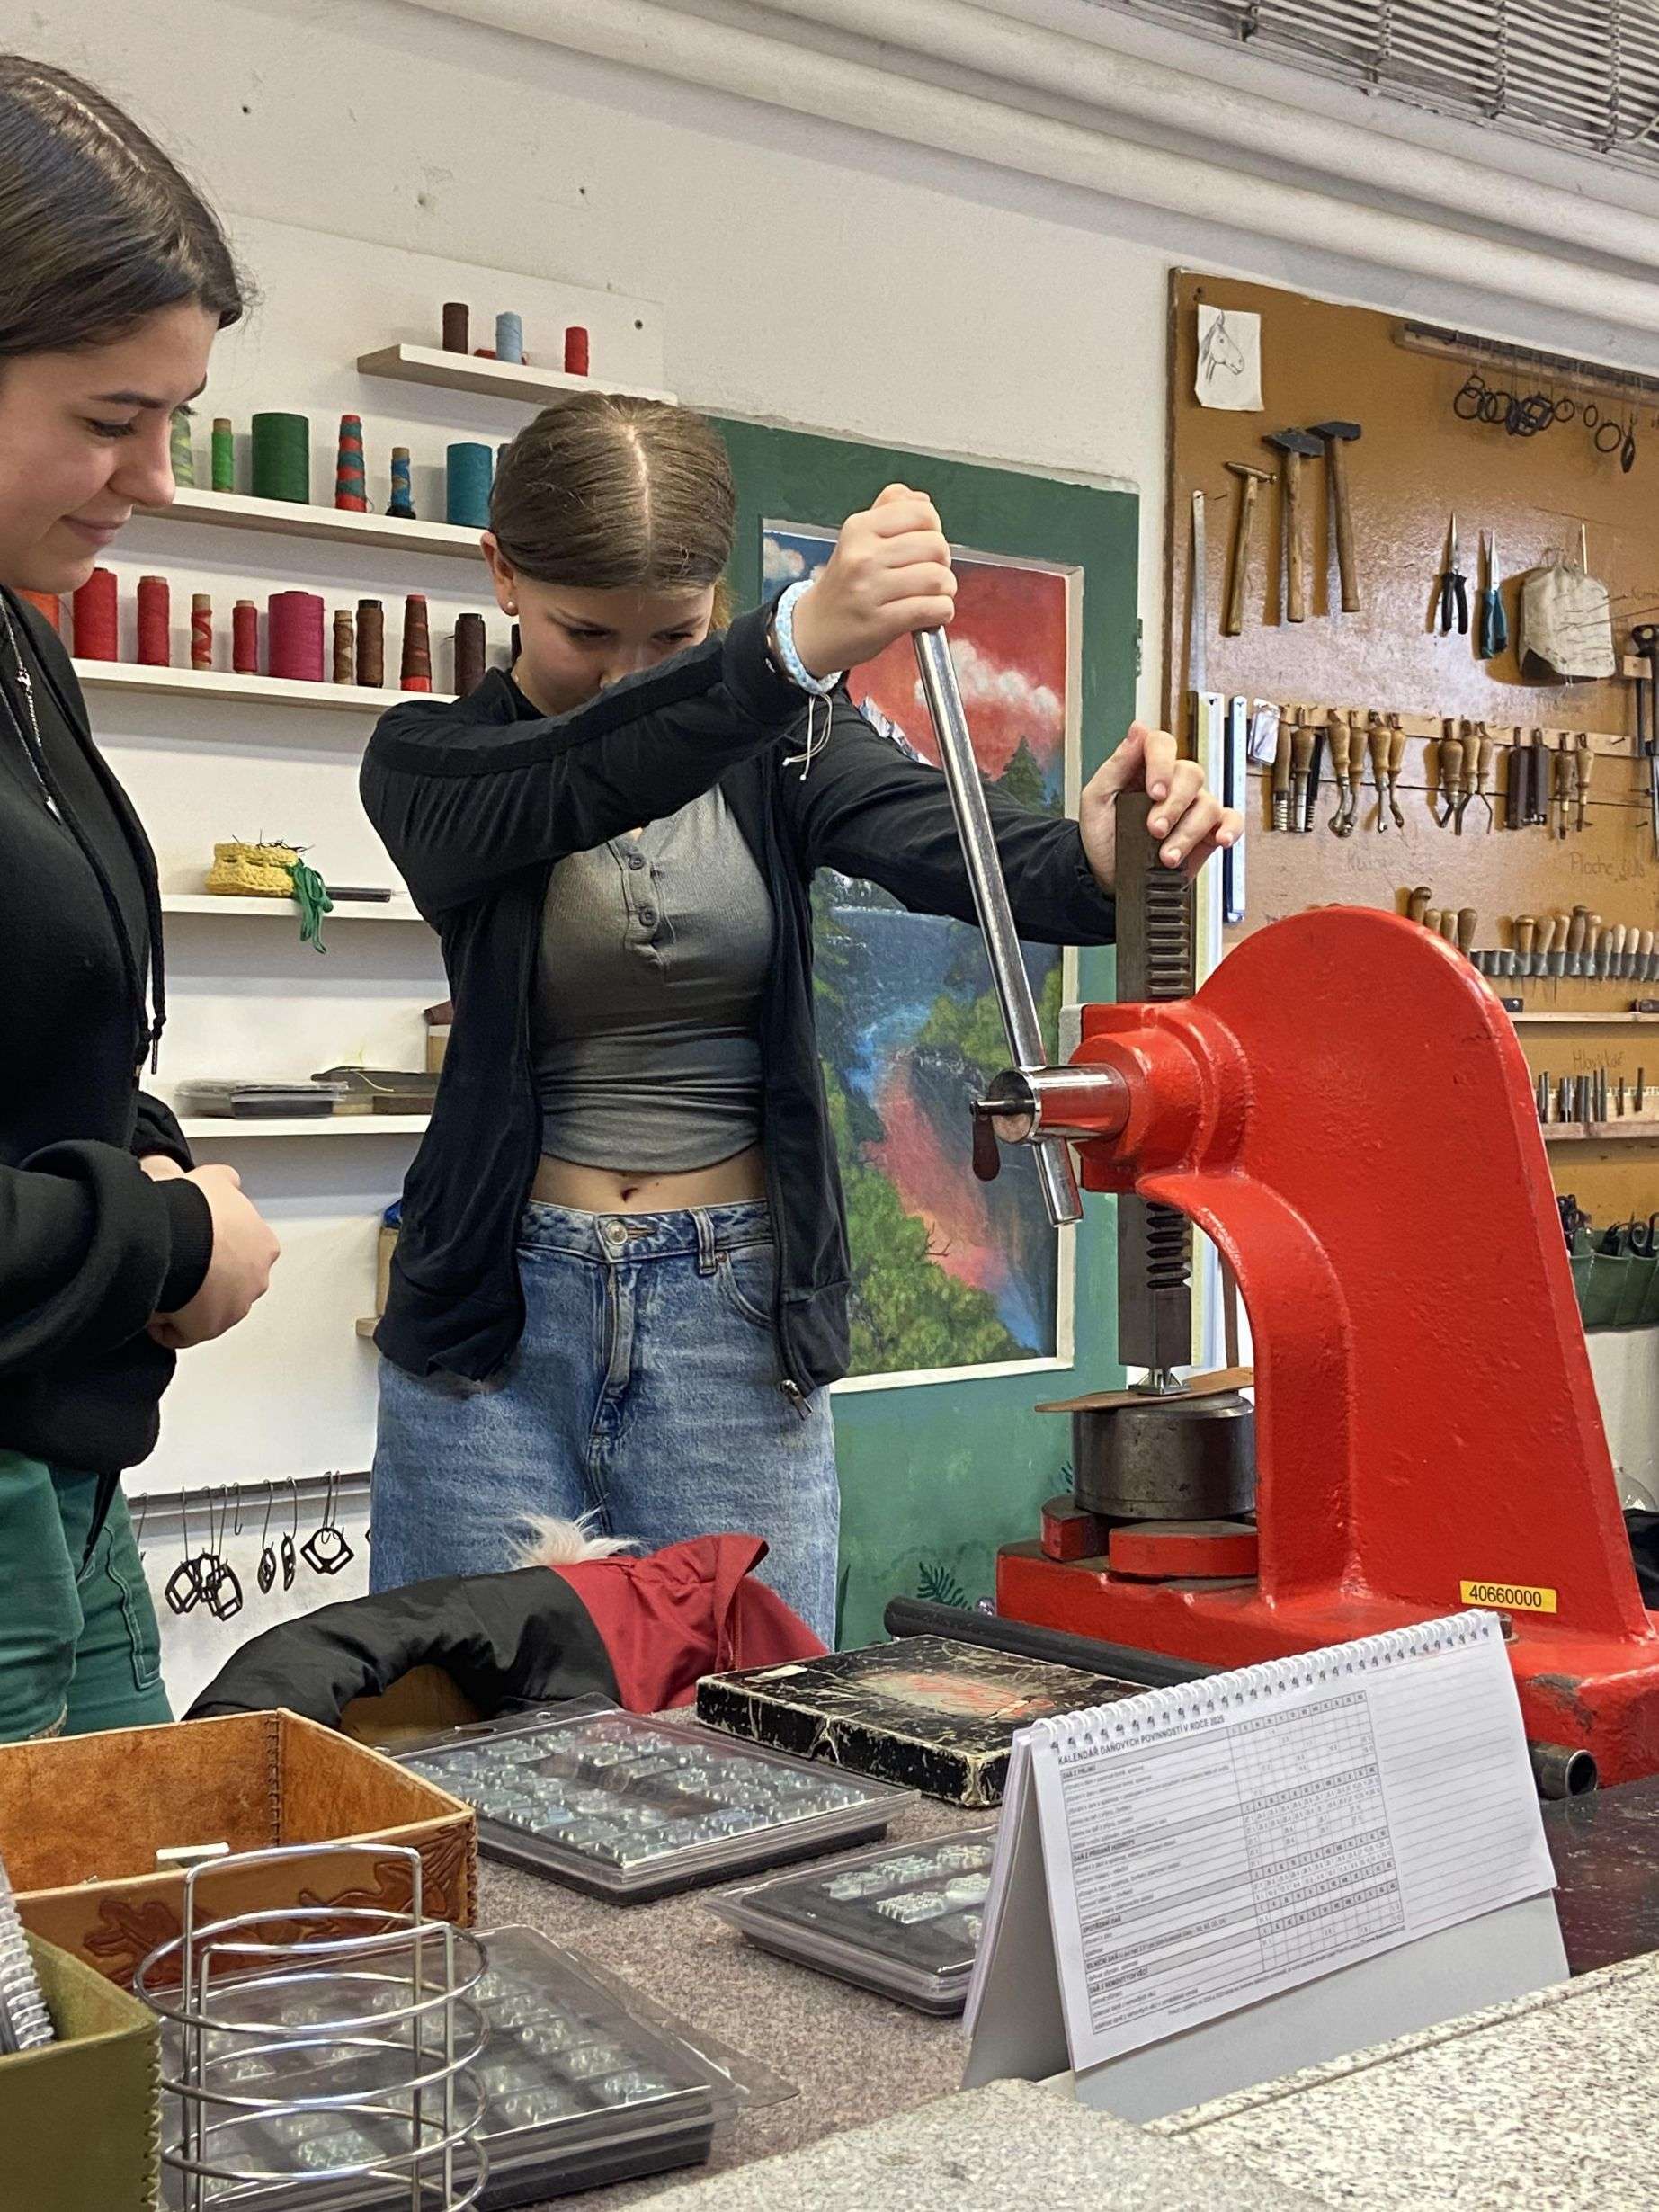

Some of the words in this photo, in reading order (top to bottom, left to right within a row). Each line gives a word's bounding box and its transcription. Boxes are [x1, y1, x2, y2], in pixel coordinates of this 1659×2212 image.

[1469, 1584, 1542, 1608] 40660000
[1057, 1744, 1099, 1765] KALENDÁŘ
[1101, 1737, 1140, 1754] DAŇOVÝCH
[1141, 1725, 1182, 1745] POVINNOSTÍ
[1190, 1719, 1209, 1730] ROCE
